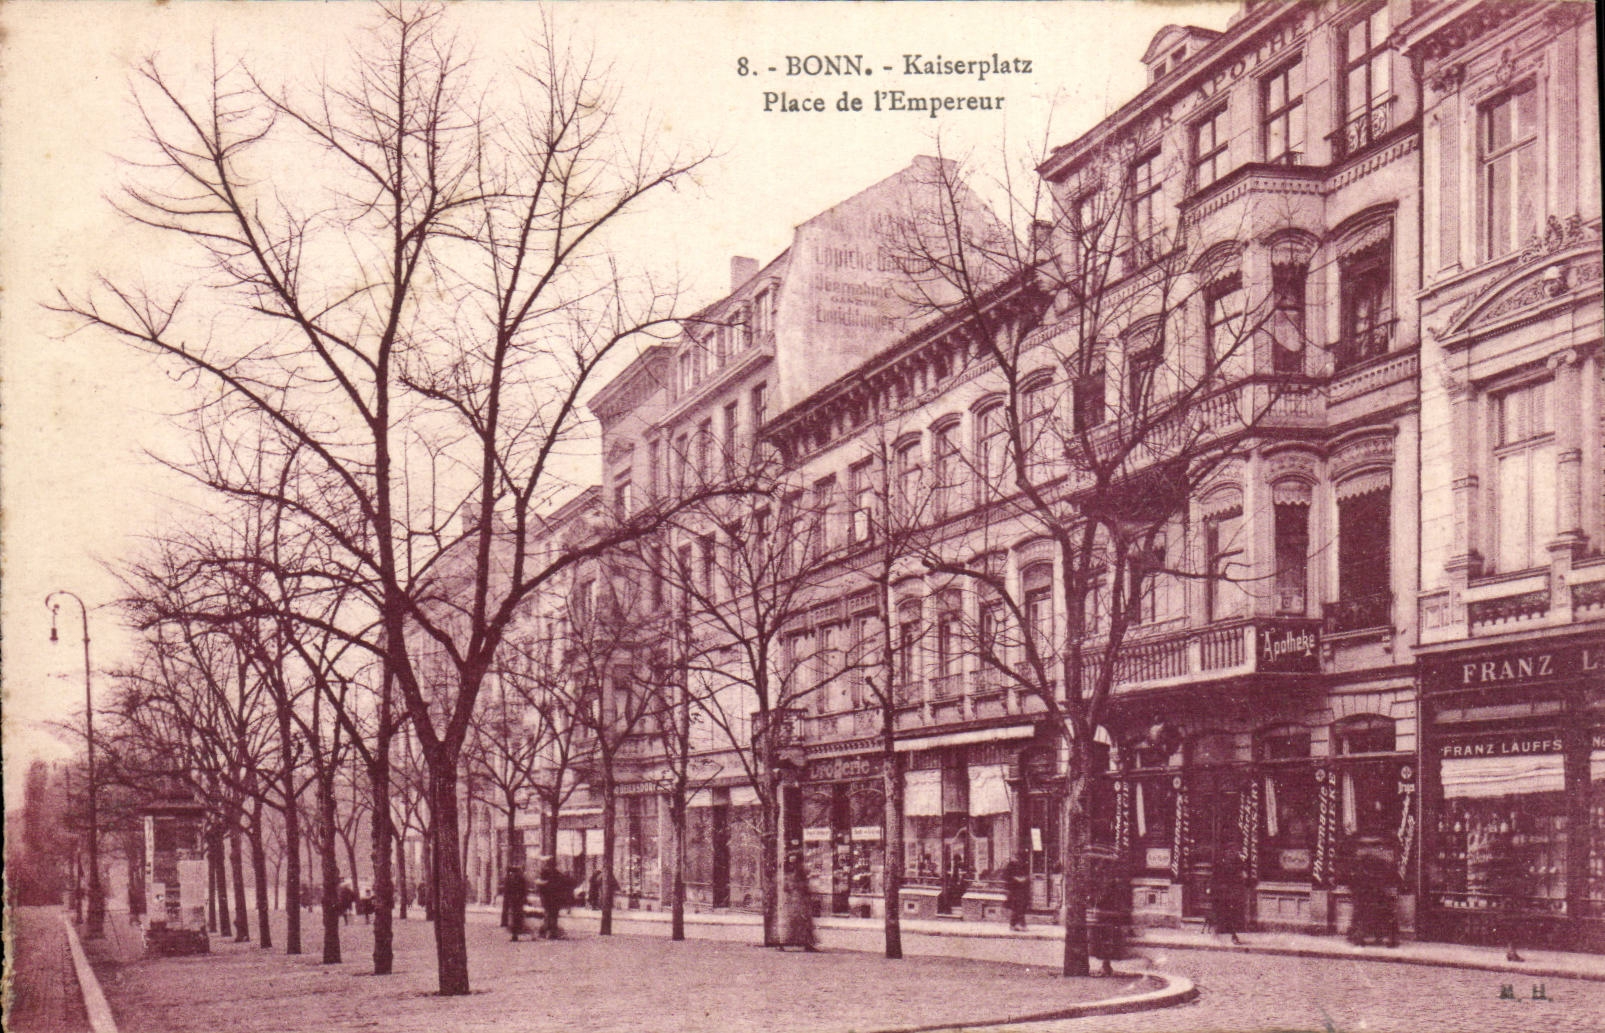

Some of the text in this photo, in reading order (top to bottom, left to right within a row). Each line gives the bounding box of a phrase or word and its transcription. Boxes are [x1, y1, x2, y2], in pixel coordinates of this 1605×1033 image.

[1260, 628, 1316, 662] Apotheke
[1462, 654, 1553, 684] FRANZ
[1442, 739, 1564, 757] FRANZ LAUFFS
